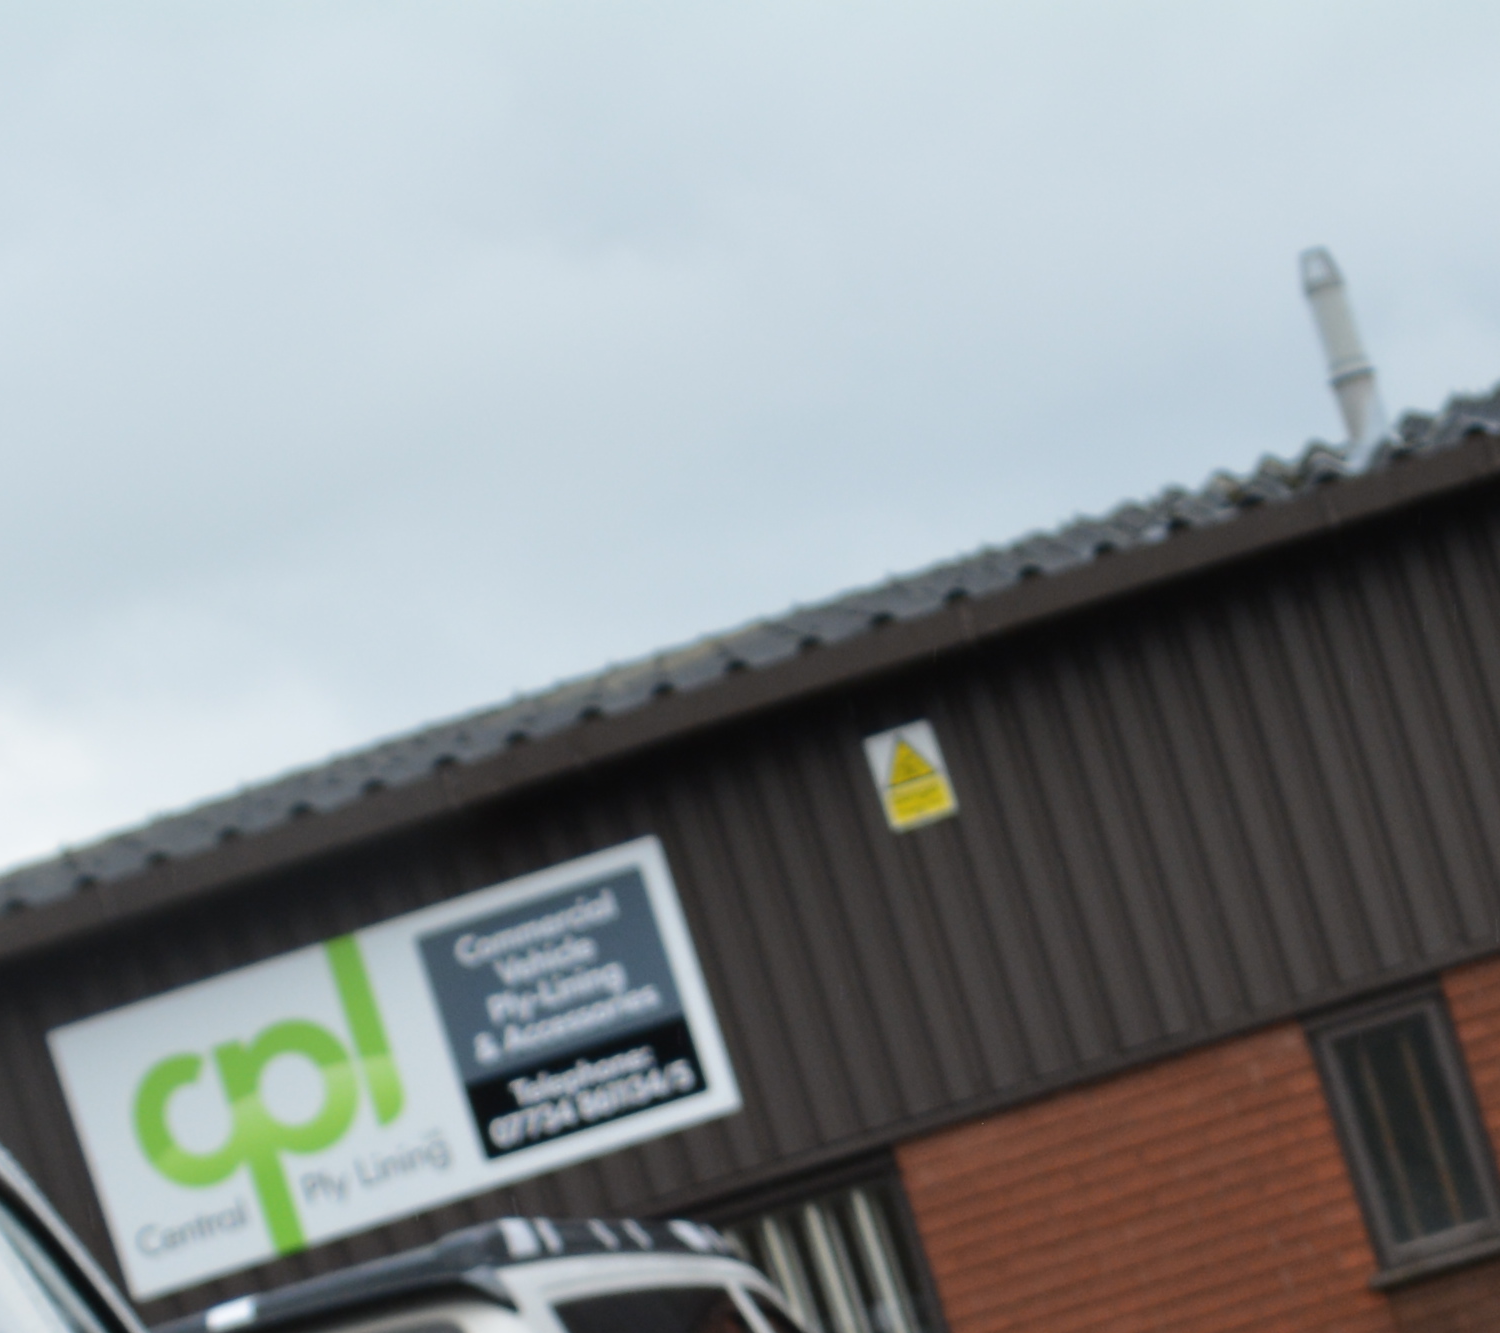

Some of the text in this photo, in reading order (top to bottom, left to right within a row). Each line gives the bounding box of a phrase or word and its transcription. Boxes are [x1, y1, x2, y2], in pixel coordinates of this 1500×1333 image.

[453, 888, 619, 969] Commercial
[491, 935, 597, 986] Vehicle
[472, 984, 660, 1066] & Accessories
[132, 934, 406, 1256] cpl
[134, 1132, 453, 1258] Central Ply Lining
